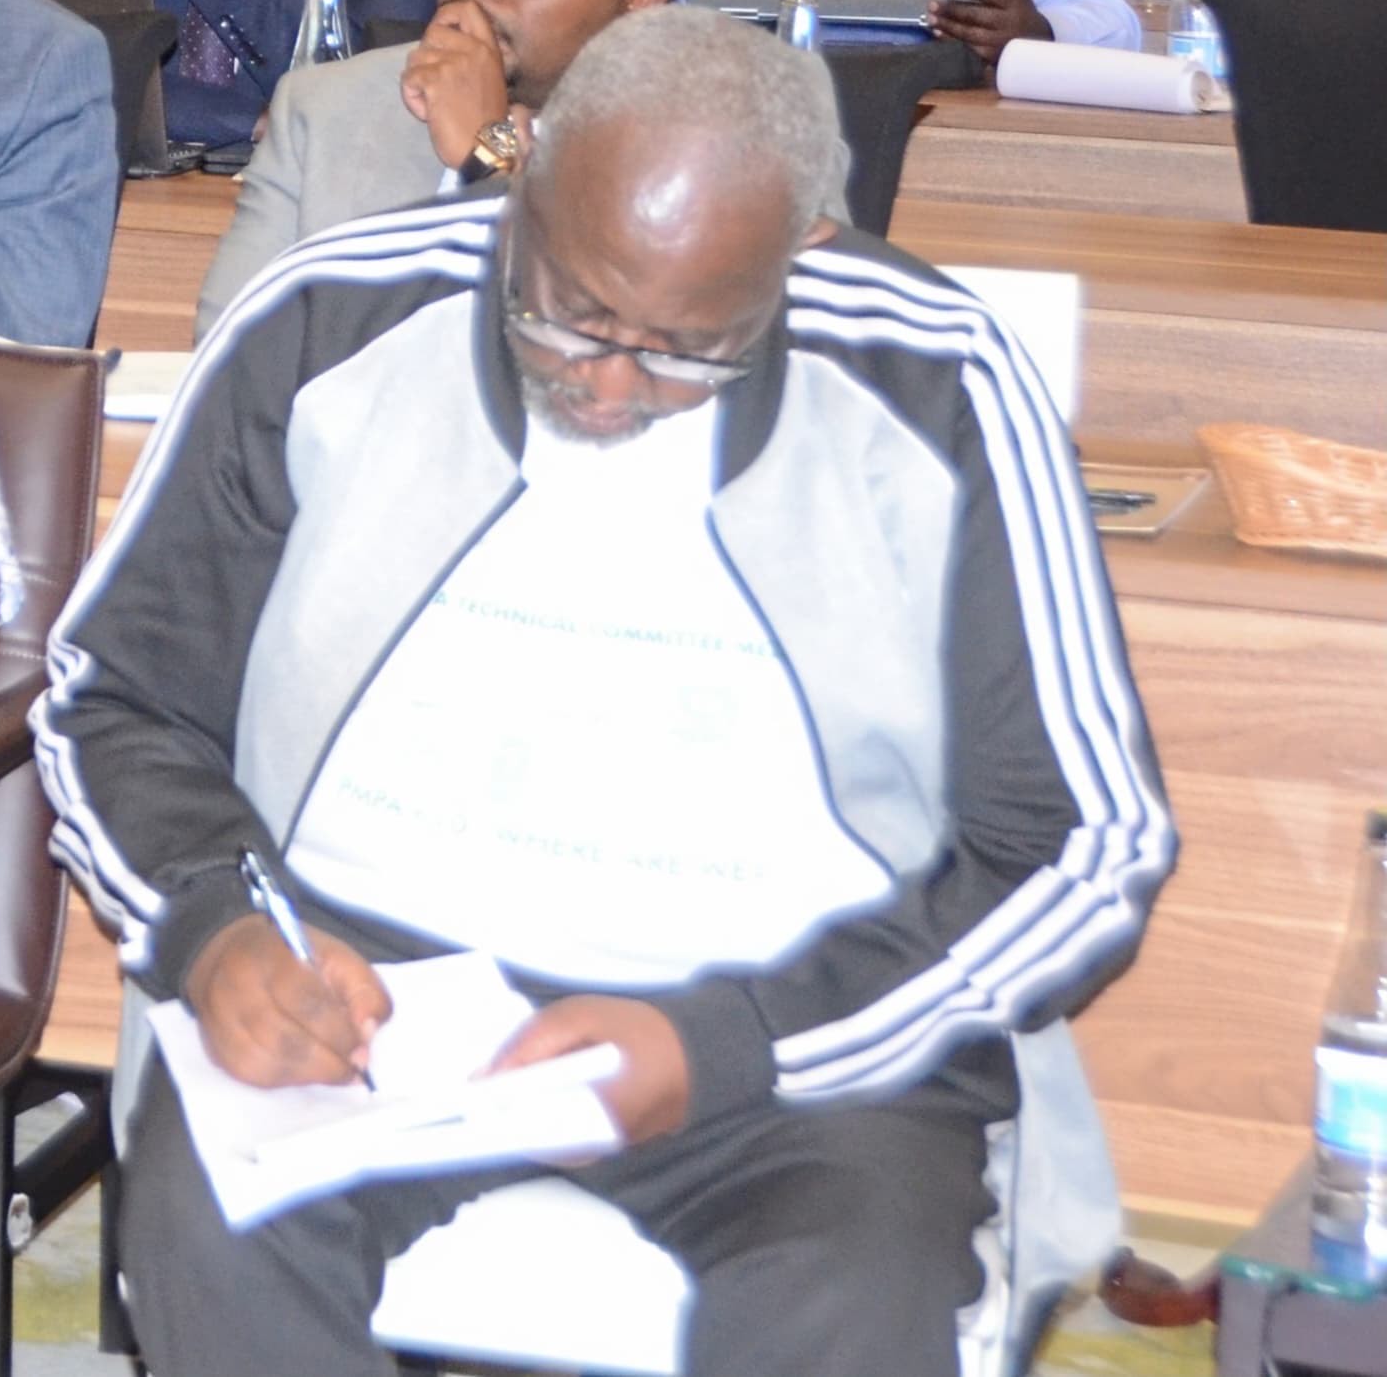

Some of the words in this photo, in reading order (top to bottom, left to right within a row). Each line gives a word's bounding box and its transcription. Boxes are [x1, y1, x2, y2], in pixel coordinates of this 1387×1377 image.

[458, 596, 578, 633] TECHNICAL
[588, 620, 724, 652] COMMITTEE
[495, 828, 604, 865] WHERE
[626, 851, 683, 878] ARE
